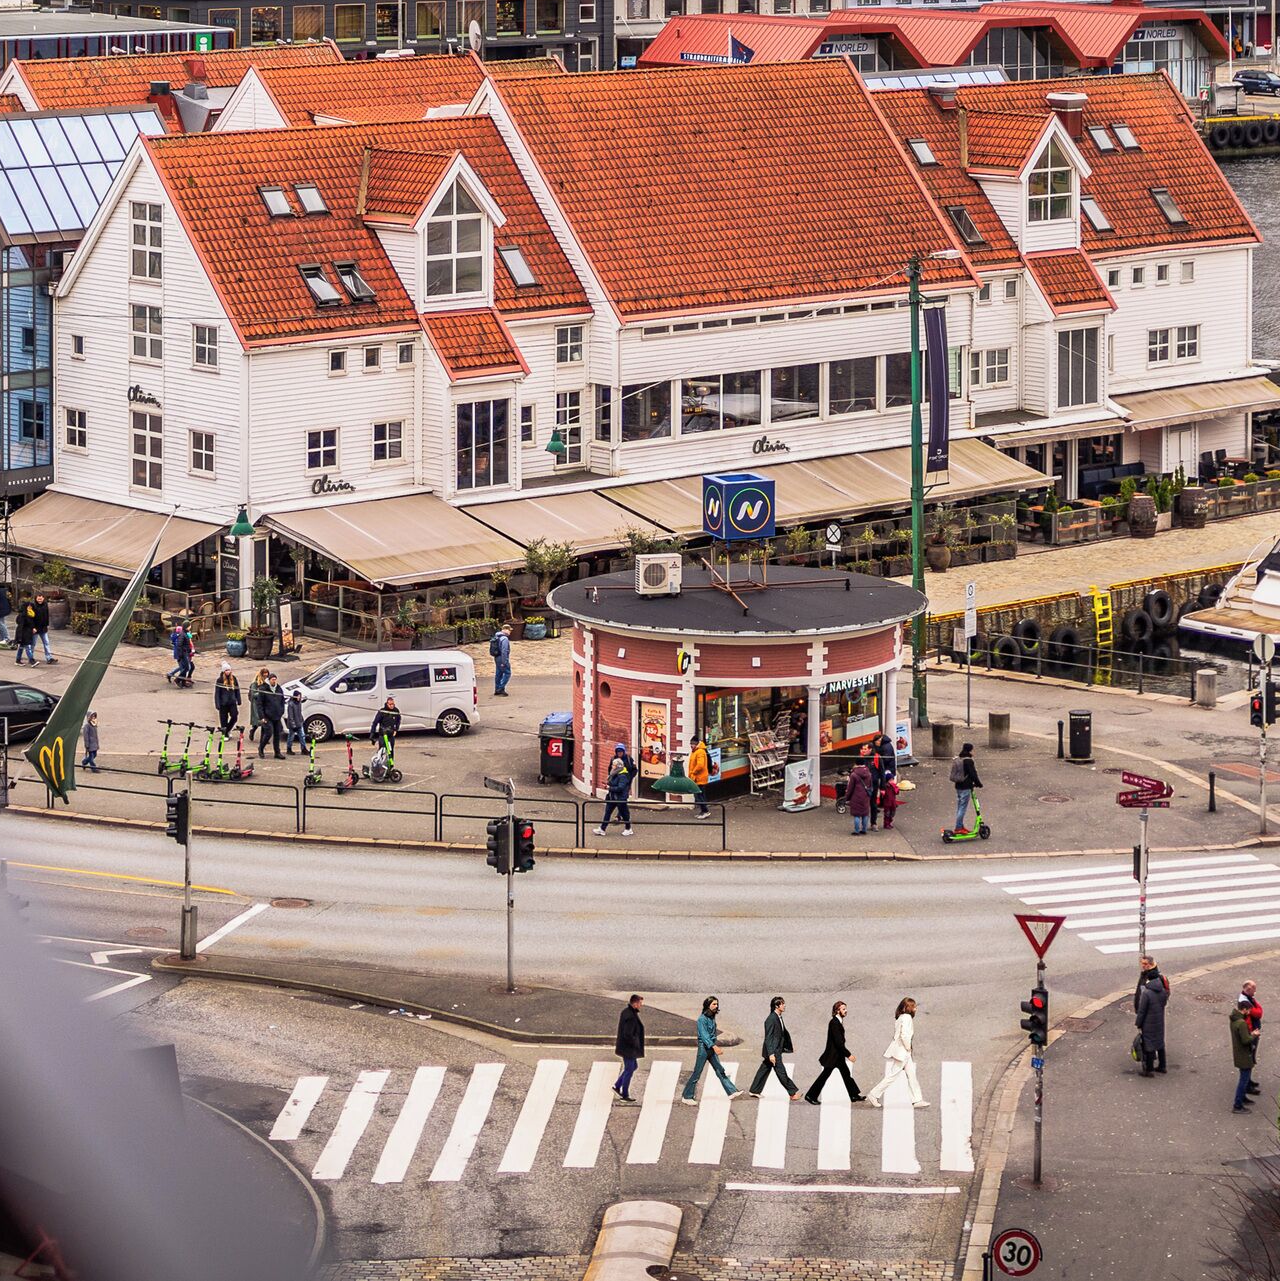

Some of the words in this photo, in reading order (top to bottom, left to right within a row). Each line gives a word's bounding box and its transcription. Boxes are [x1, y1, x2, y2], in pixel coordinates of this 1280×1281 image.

[1146, 28, 1177, 39] NORLED
[835, 42, 869, 54] NORLED
[752, 435, 790, 454] Olivia
[312, 474, 356, 494] Olivia
[829, 674, 875, 692] NARVESEN
[1003, 1241, 1032, 1266] 30
